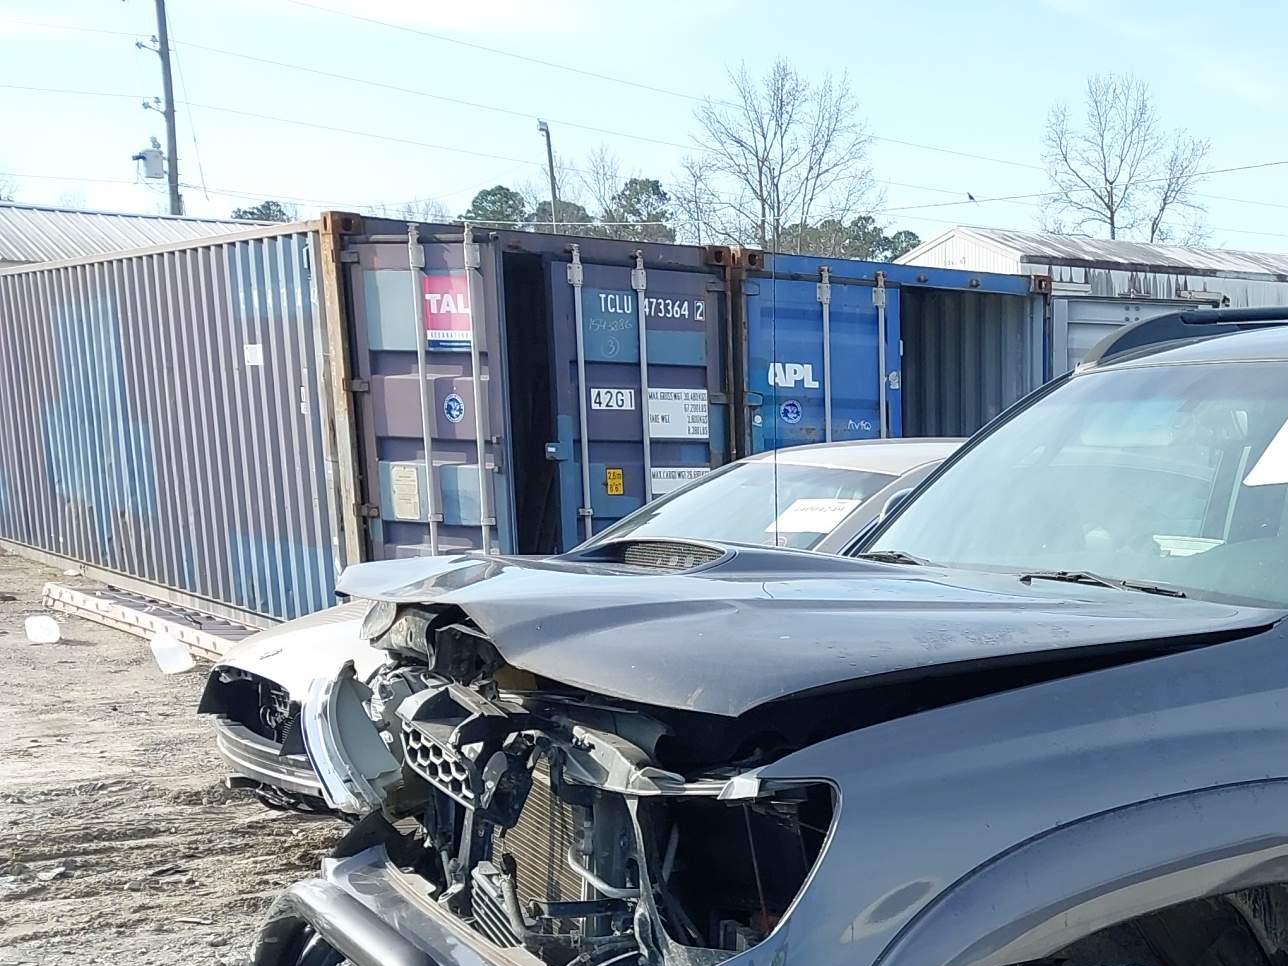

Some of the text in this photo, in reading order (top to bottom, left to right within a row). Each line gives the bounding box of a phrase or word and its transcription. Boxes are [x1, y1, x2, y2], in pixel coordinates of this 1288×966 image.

[425, 293, 470, 314] TAL
[599, 293, 705, 320] TCLU 473364 2
[768, 363, 819, 388] APL
[594, 390, 633, 409] 42G1
